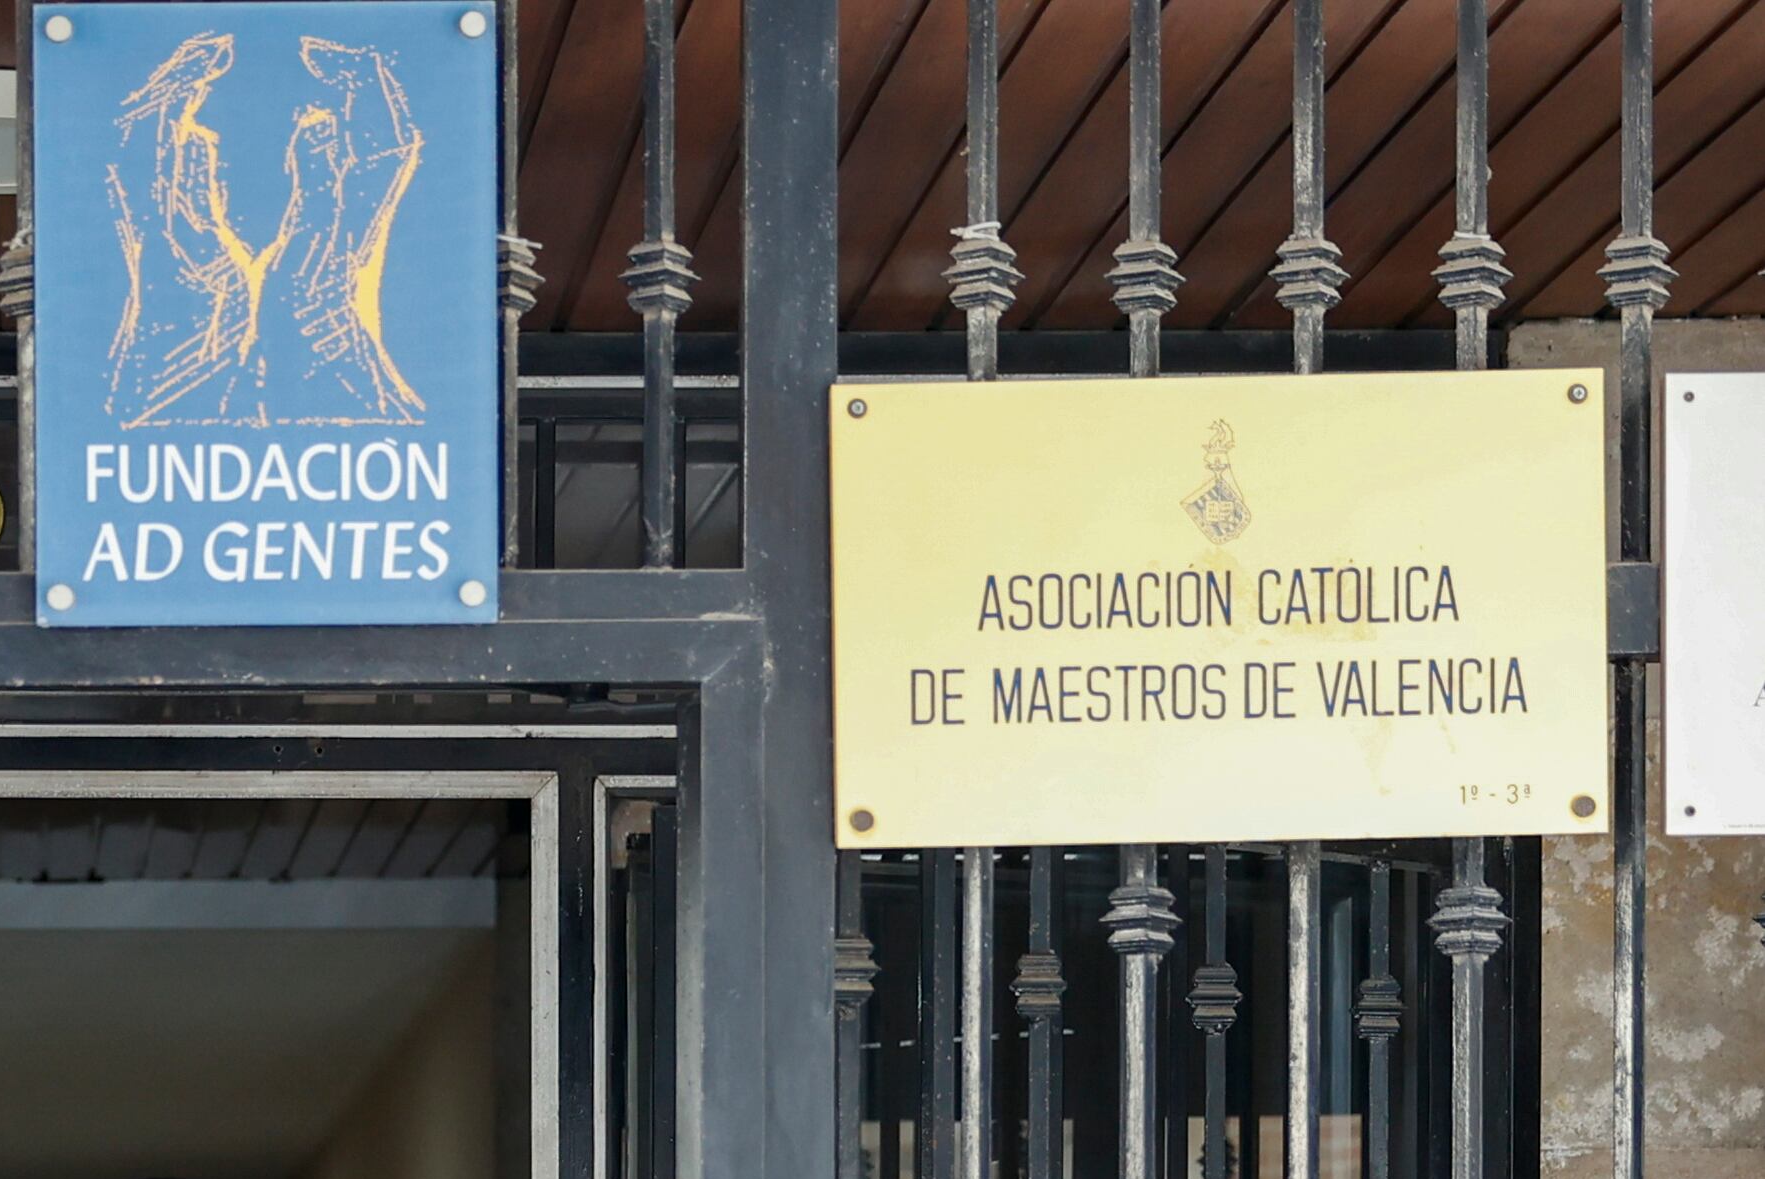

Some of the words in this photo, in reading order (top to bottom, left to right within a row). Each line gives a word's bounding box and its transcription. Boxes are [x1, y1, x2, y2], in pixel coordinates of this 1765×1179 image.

[83, 522, 183, 581] AD
[203, 520, 451, 582] GENTES
[910, 668, 967, 726] DE
[992, 663, 1228, 725] MAESTROS
[1243, 661, 1297, 719] DE
[1315, 656, 1529, 718] VALENCIA
